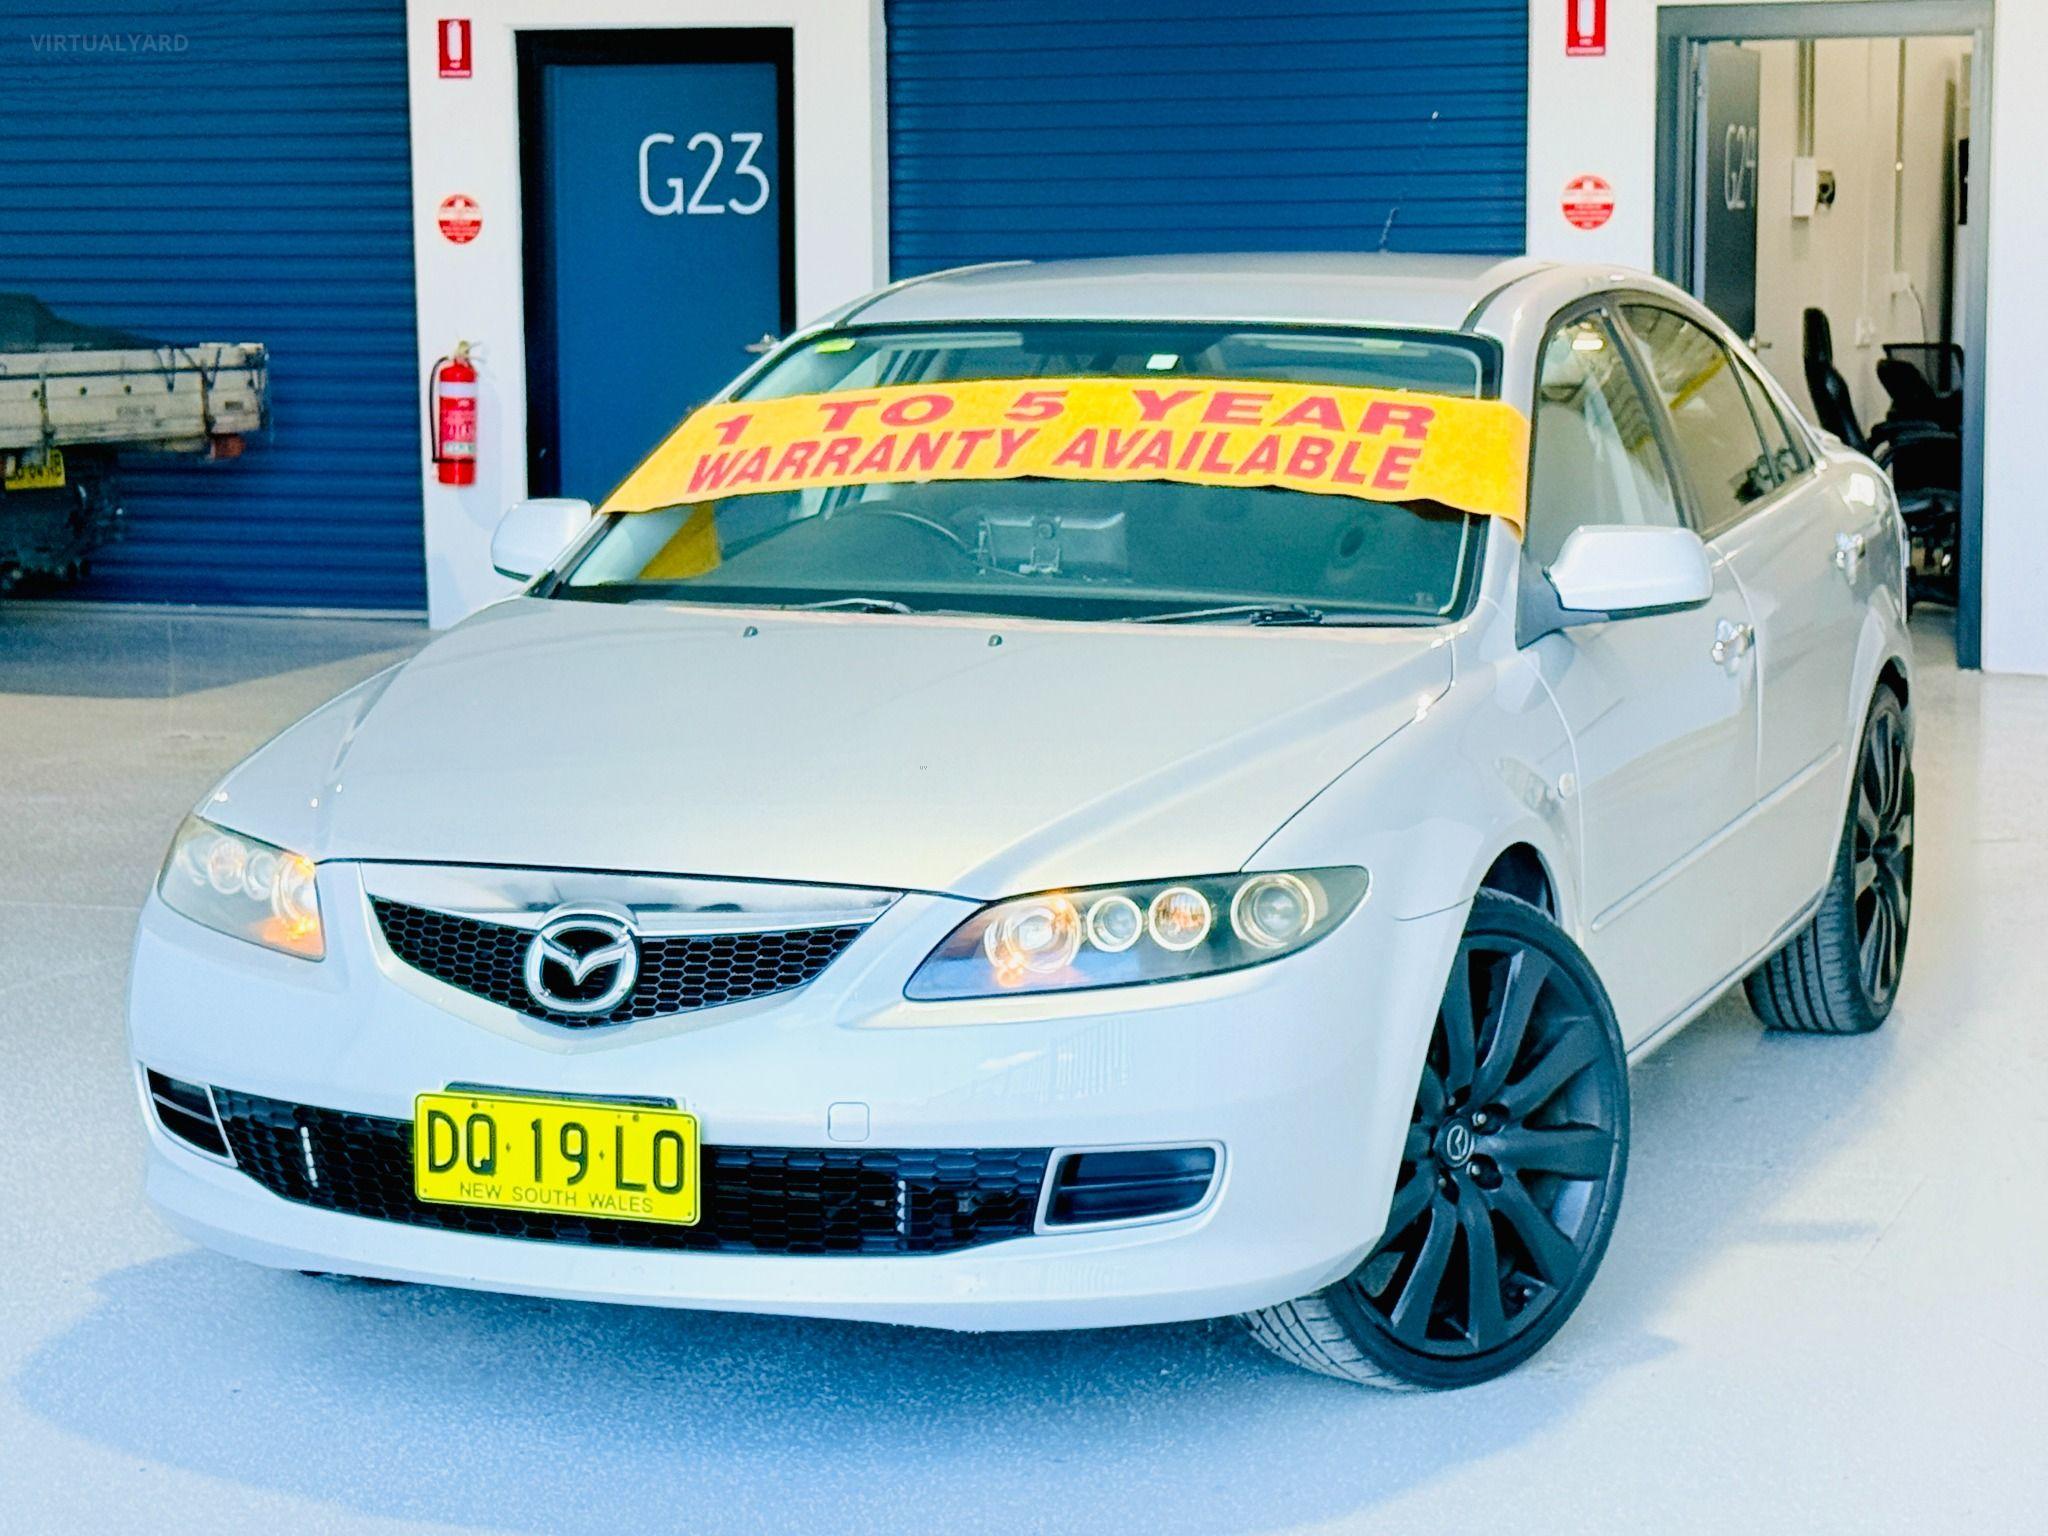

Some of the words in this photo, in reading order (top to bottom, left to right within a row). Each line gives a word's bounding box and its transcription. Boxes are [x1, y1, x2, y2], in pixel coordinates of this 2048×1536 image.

[638, 131, 771, 217] G23
[714, 414, 754, 446] 1
[818, 394, 954, 433] TO
[1004, 391, 1069, 422] 5
[1132, 390, 1436, 439] YEAR
[686, 428, 1040, 495] WARRANTY
[1051, 428, 1422, 491] AVAILABLE
[460, 1181, 503, 1200] NEW
[511, 1185, 577, 1206] SOUTH
[588, 1192, 654, 1213] WALES
